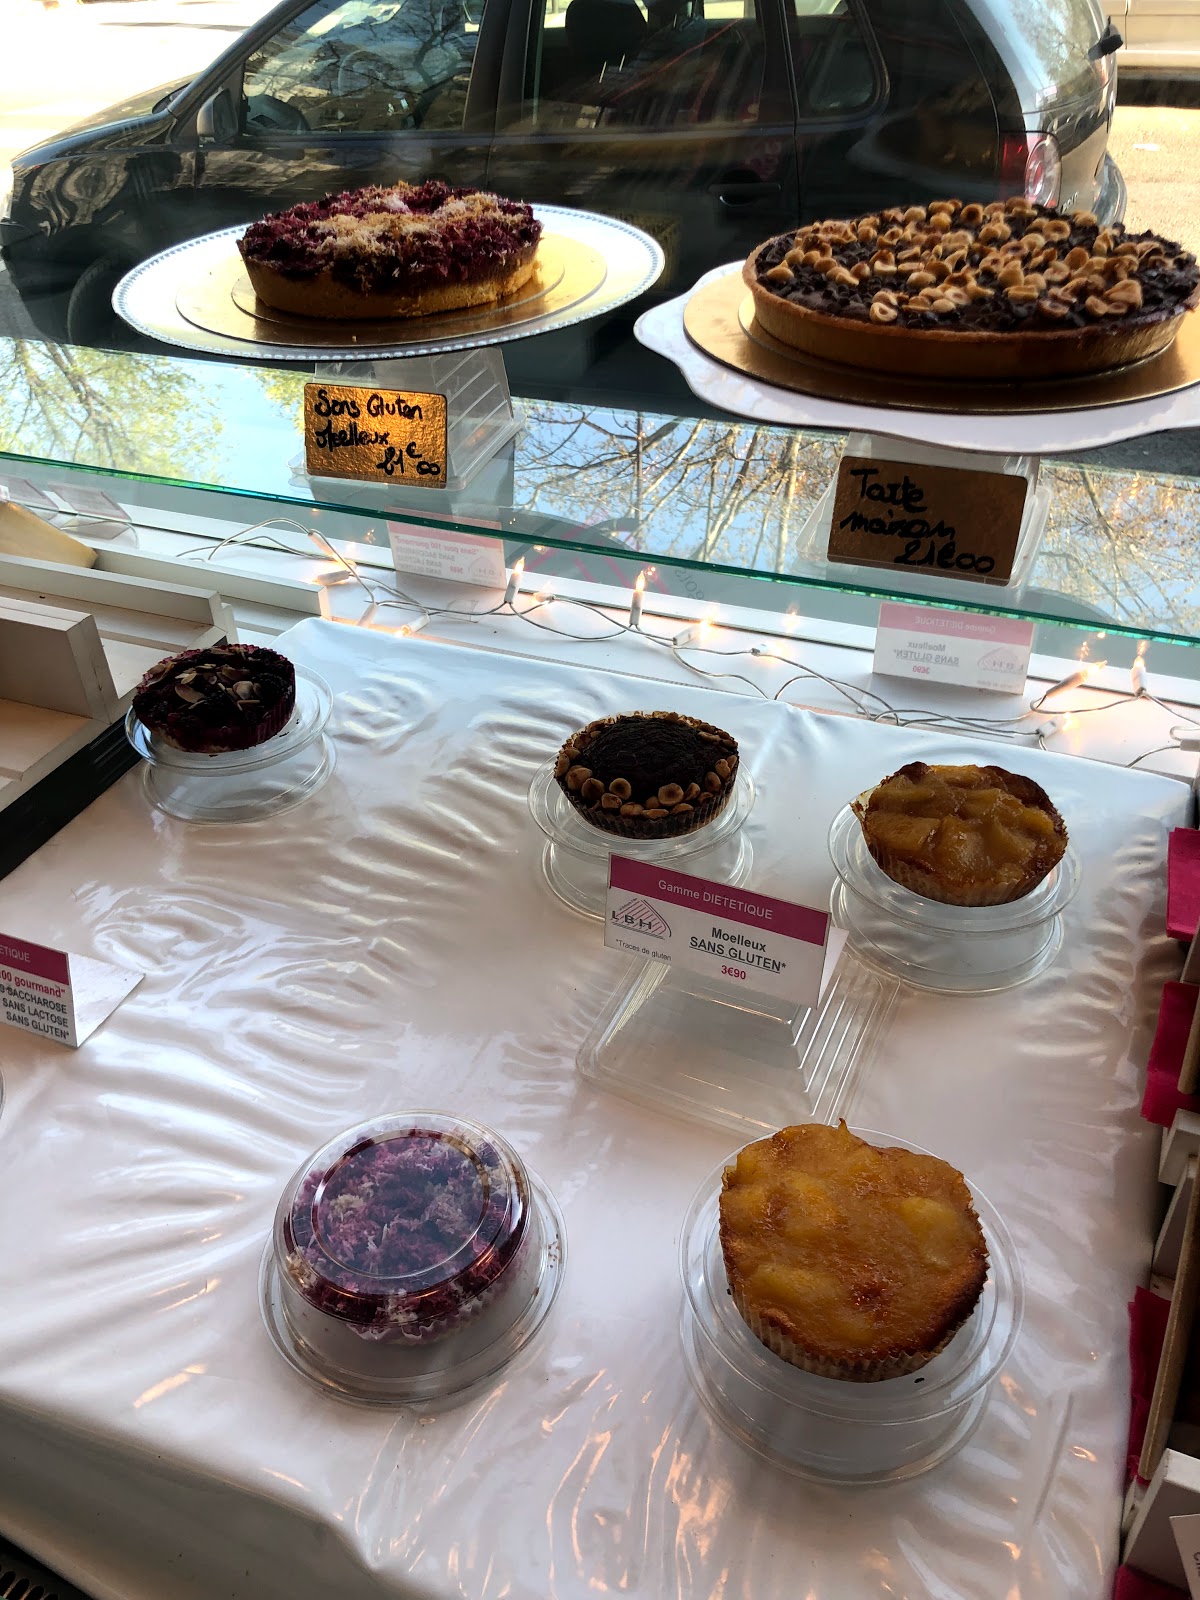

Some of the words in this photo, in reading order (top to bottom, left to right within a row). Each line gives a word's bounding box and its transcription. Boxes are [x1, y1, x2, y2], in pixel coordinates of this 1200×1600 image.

[314, 389, 361, 418] Sans
[366, 393, 423, 420] Gluten
[850, 468, 928, 513] Tarte
[658, 880, 700, 900] Gamme
[702, 891, 773, 920] DIETETIQUE
[689, 936, 725, 956] SANS
[711, 927, 767, 953] Moelleux
[641, 947, 650, 955] de
[651, 950, 672, 962] gluten
[720, 964, 747, 980] 3€90
[2, 997, 26, 1014] SANS
[27, 1006, 69, 1028] LACTOSE
[6, 1011, 30, 1026] SANS
